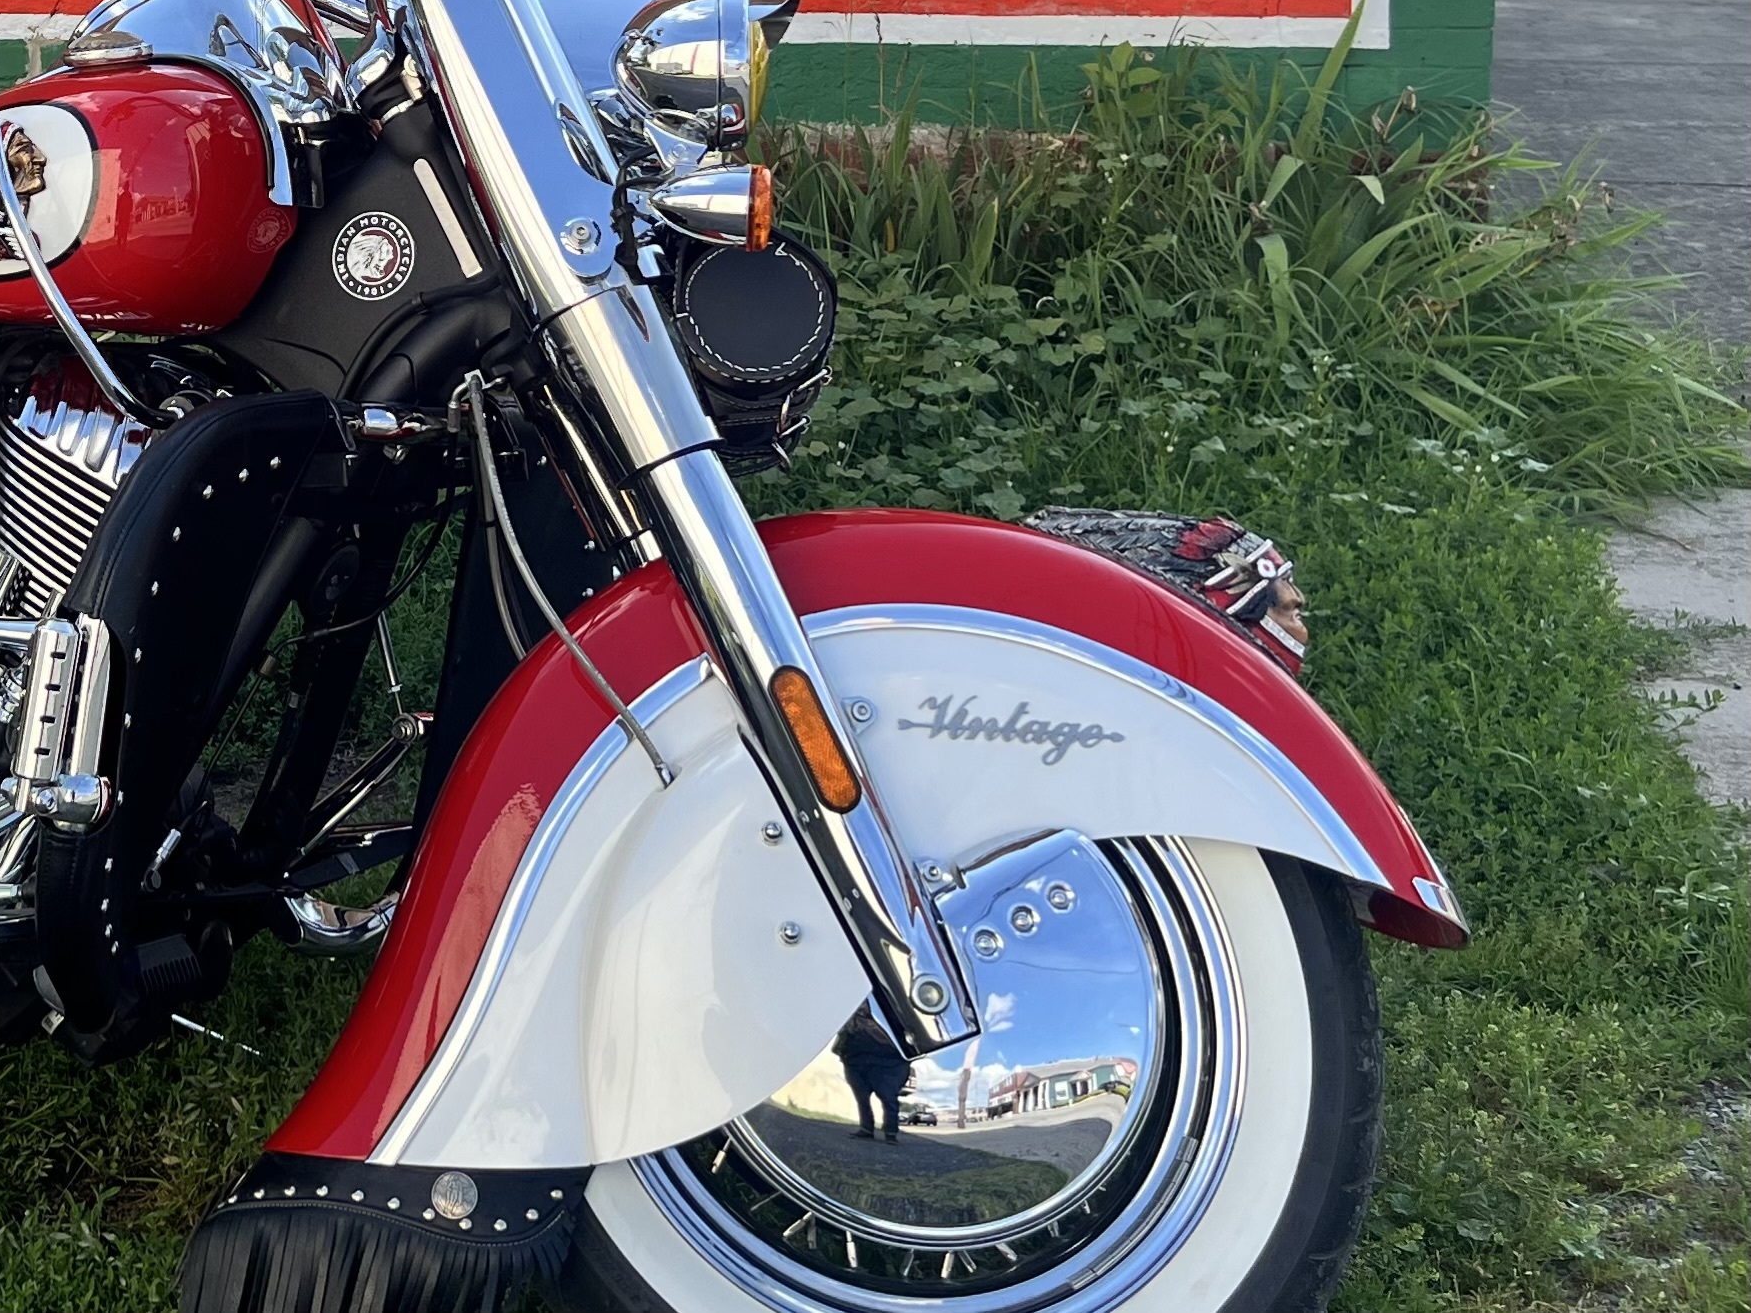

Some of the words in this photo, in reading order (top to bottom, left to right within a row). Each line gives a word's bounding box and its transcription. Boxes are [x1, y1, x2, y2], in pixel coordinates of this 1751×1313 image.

[336, 226, 357, 281] INDIAN
[359, 216, 411, 282] MOTORCYCLE
[356, 284, 385, 296] 1901
[898, 694, 1126, 766] Vintage
